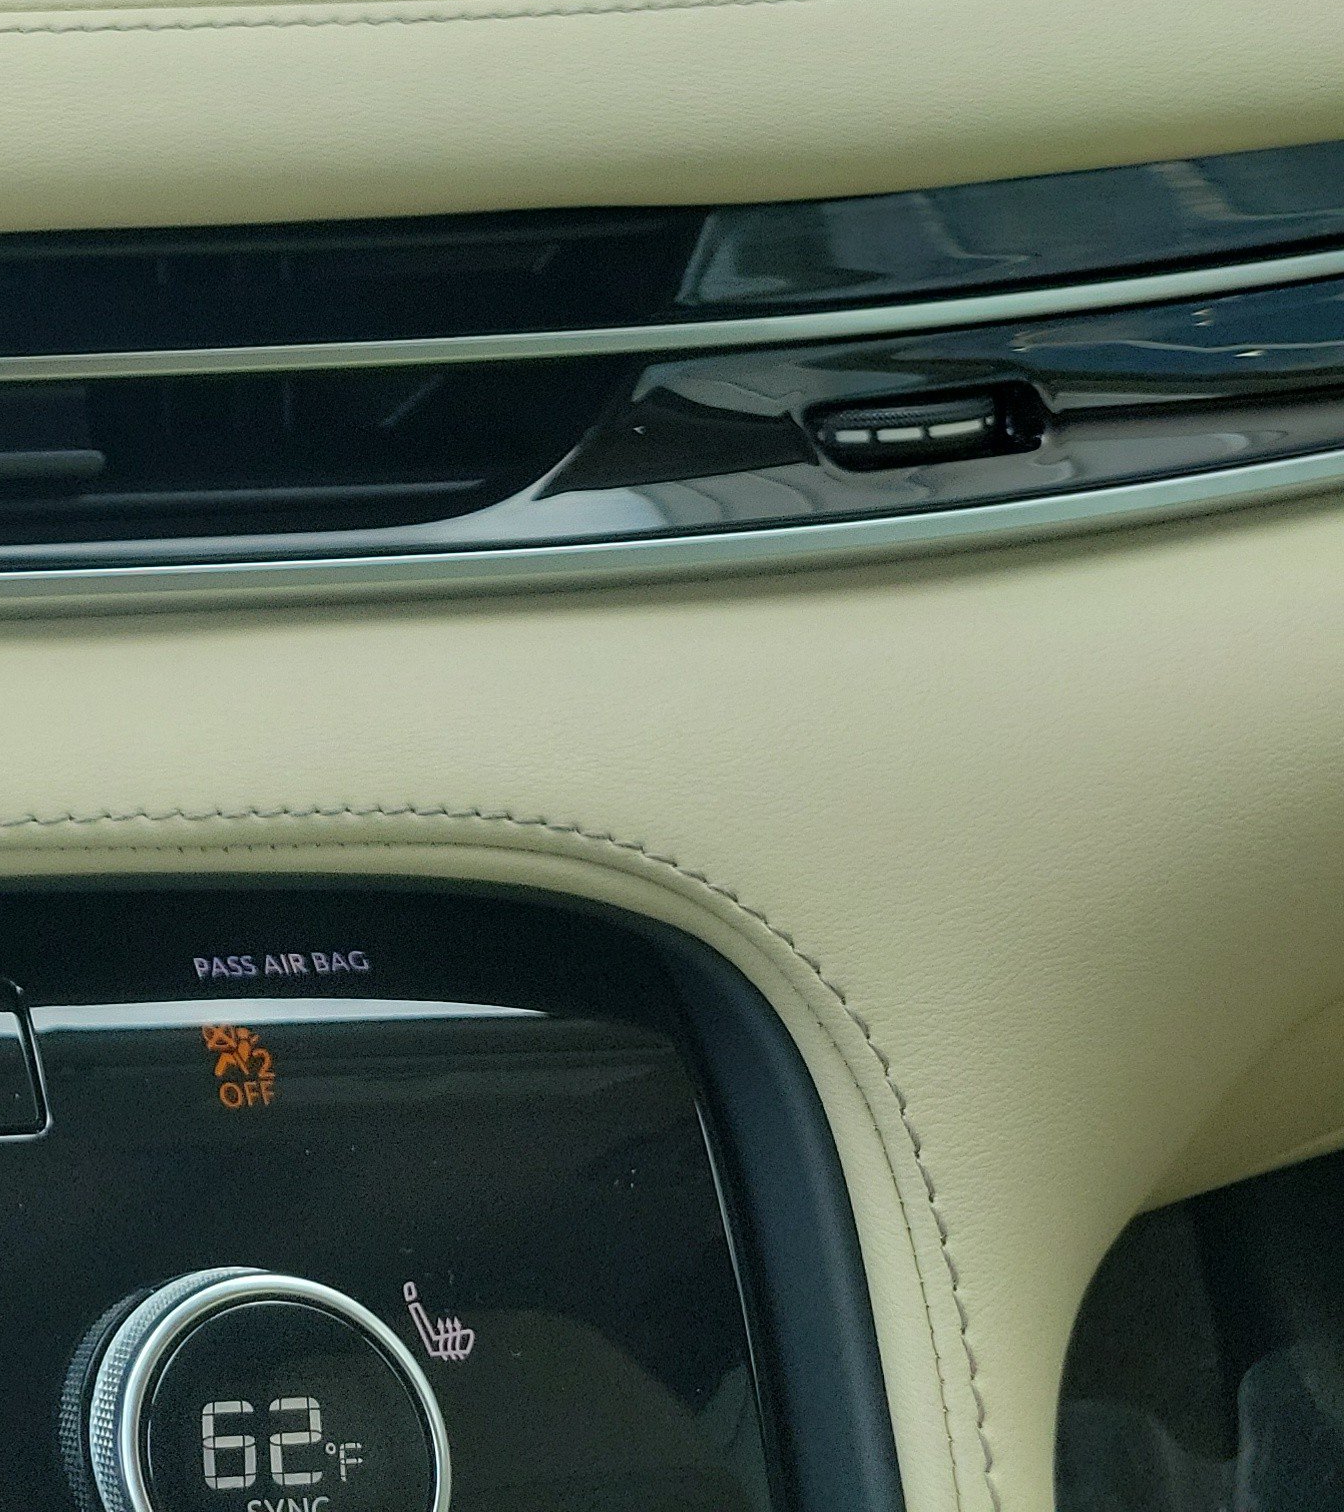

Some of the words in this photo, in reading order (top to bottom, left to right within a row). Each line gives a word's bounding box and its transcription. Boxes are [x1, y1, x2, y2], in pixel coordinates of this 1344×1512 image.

[192, 955, 259, 980] PASS
[264, 952, 309, 976] AIR
[311, 950, 371, 975] BAG
[219, 1079, 275, 1109] OFF
